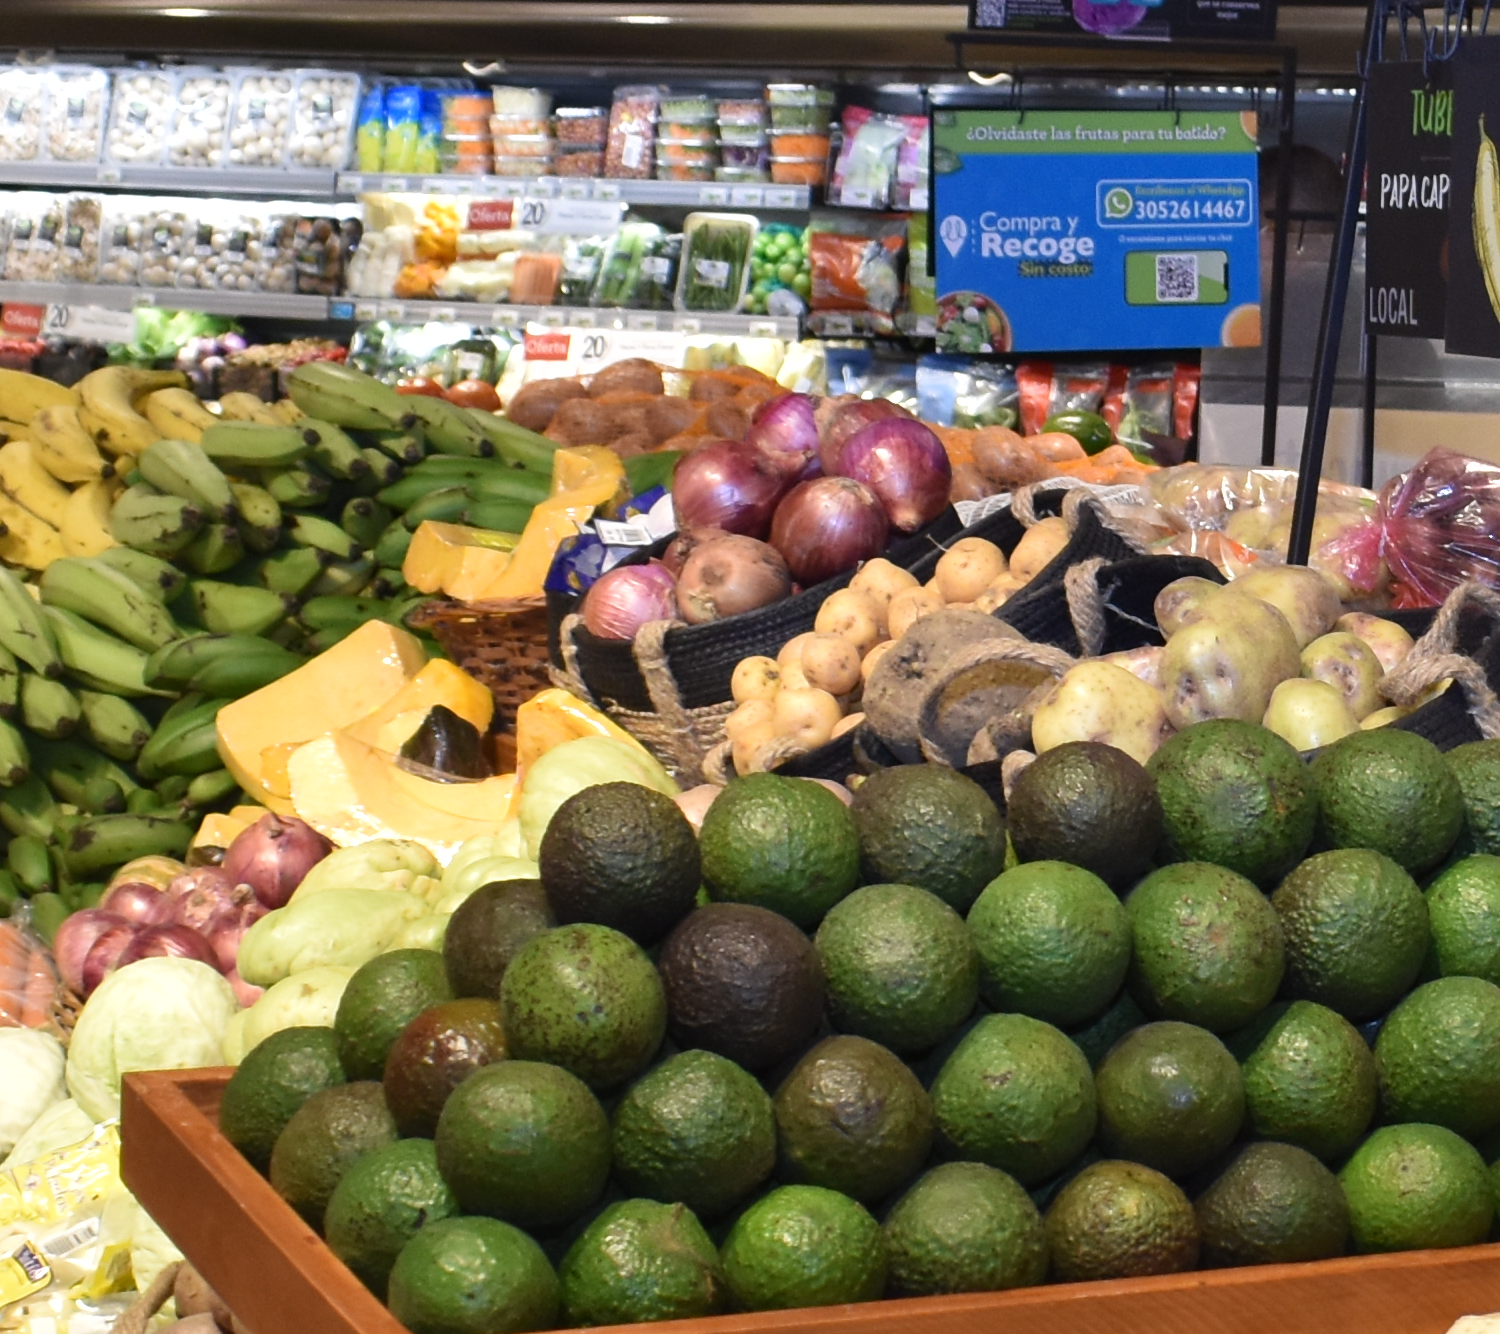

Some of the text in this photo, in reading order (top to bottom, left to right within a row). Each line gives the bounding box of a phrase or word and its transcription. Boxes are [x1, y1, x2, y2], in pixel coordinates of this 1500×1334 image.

[1050, 125, 1072, 141] las
[1074, 125, 1120, 143] frutas
[1122, 128, 1156, 144] para
[1157, 127, 1174, 142] tu
[1174, 124, 1227, 142] batido?
[1379, 172, 1419, 210] PAPA
[979, 211, 1079, 236] Compra y
[1134, 199, 1246, 221] 3052614467
[981, 232, 1095, 264] Recoge
[1368, 286, 1418, 326] LOCAL
